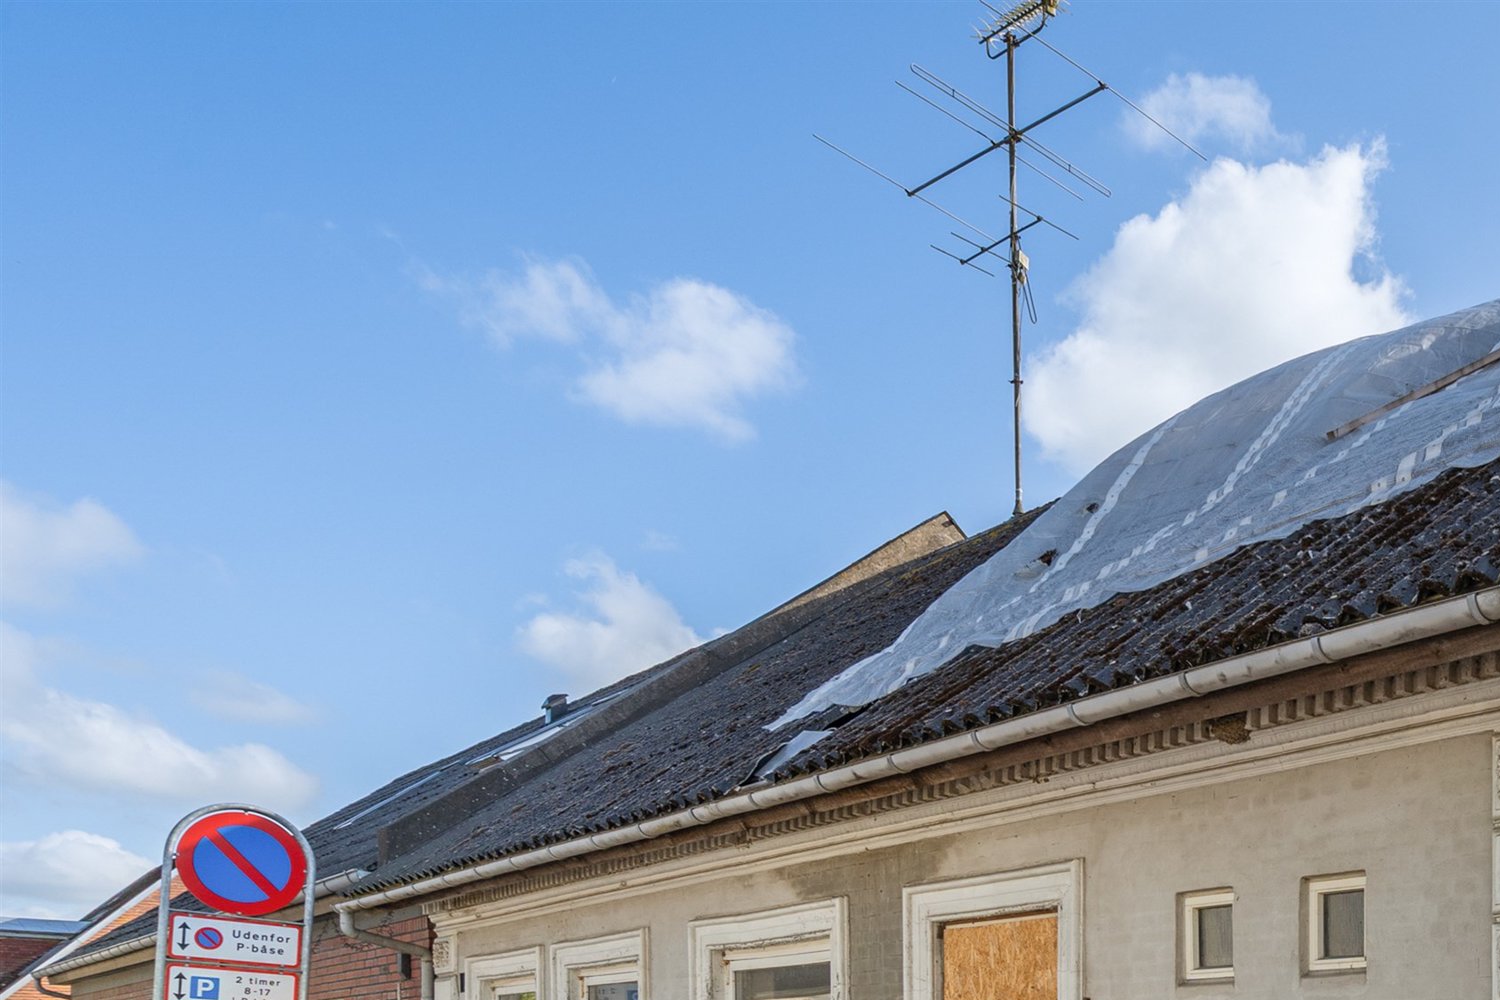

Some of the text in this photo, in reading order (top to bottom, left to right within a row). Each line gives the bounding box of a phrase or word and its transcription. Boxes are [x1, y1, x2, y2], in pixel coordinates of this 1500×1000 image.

[232, 929, 291, 943] Udenfor
[235, 976, 281, 986] 2 timer
[196, 978, 215, 997] P
[244, 987, 271, 996] 8-17
